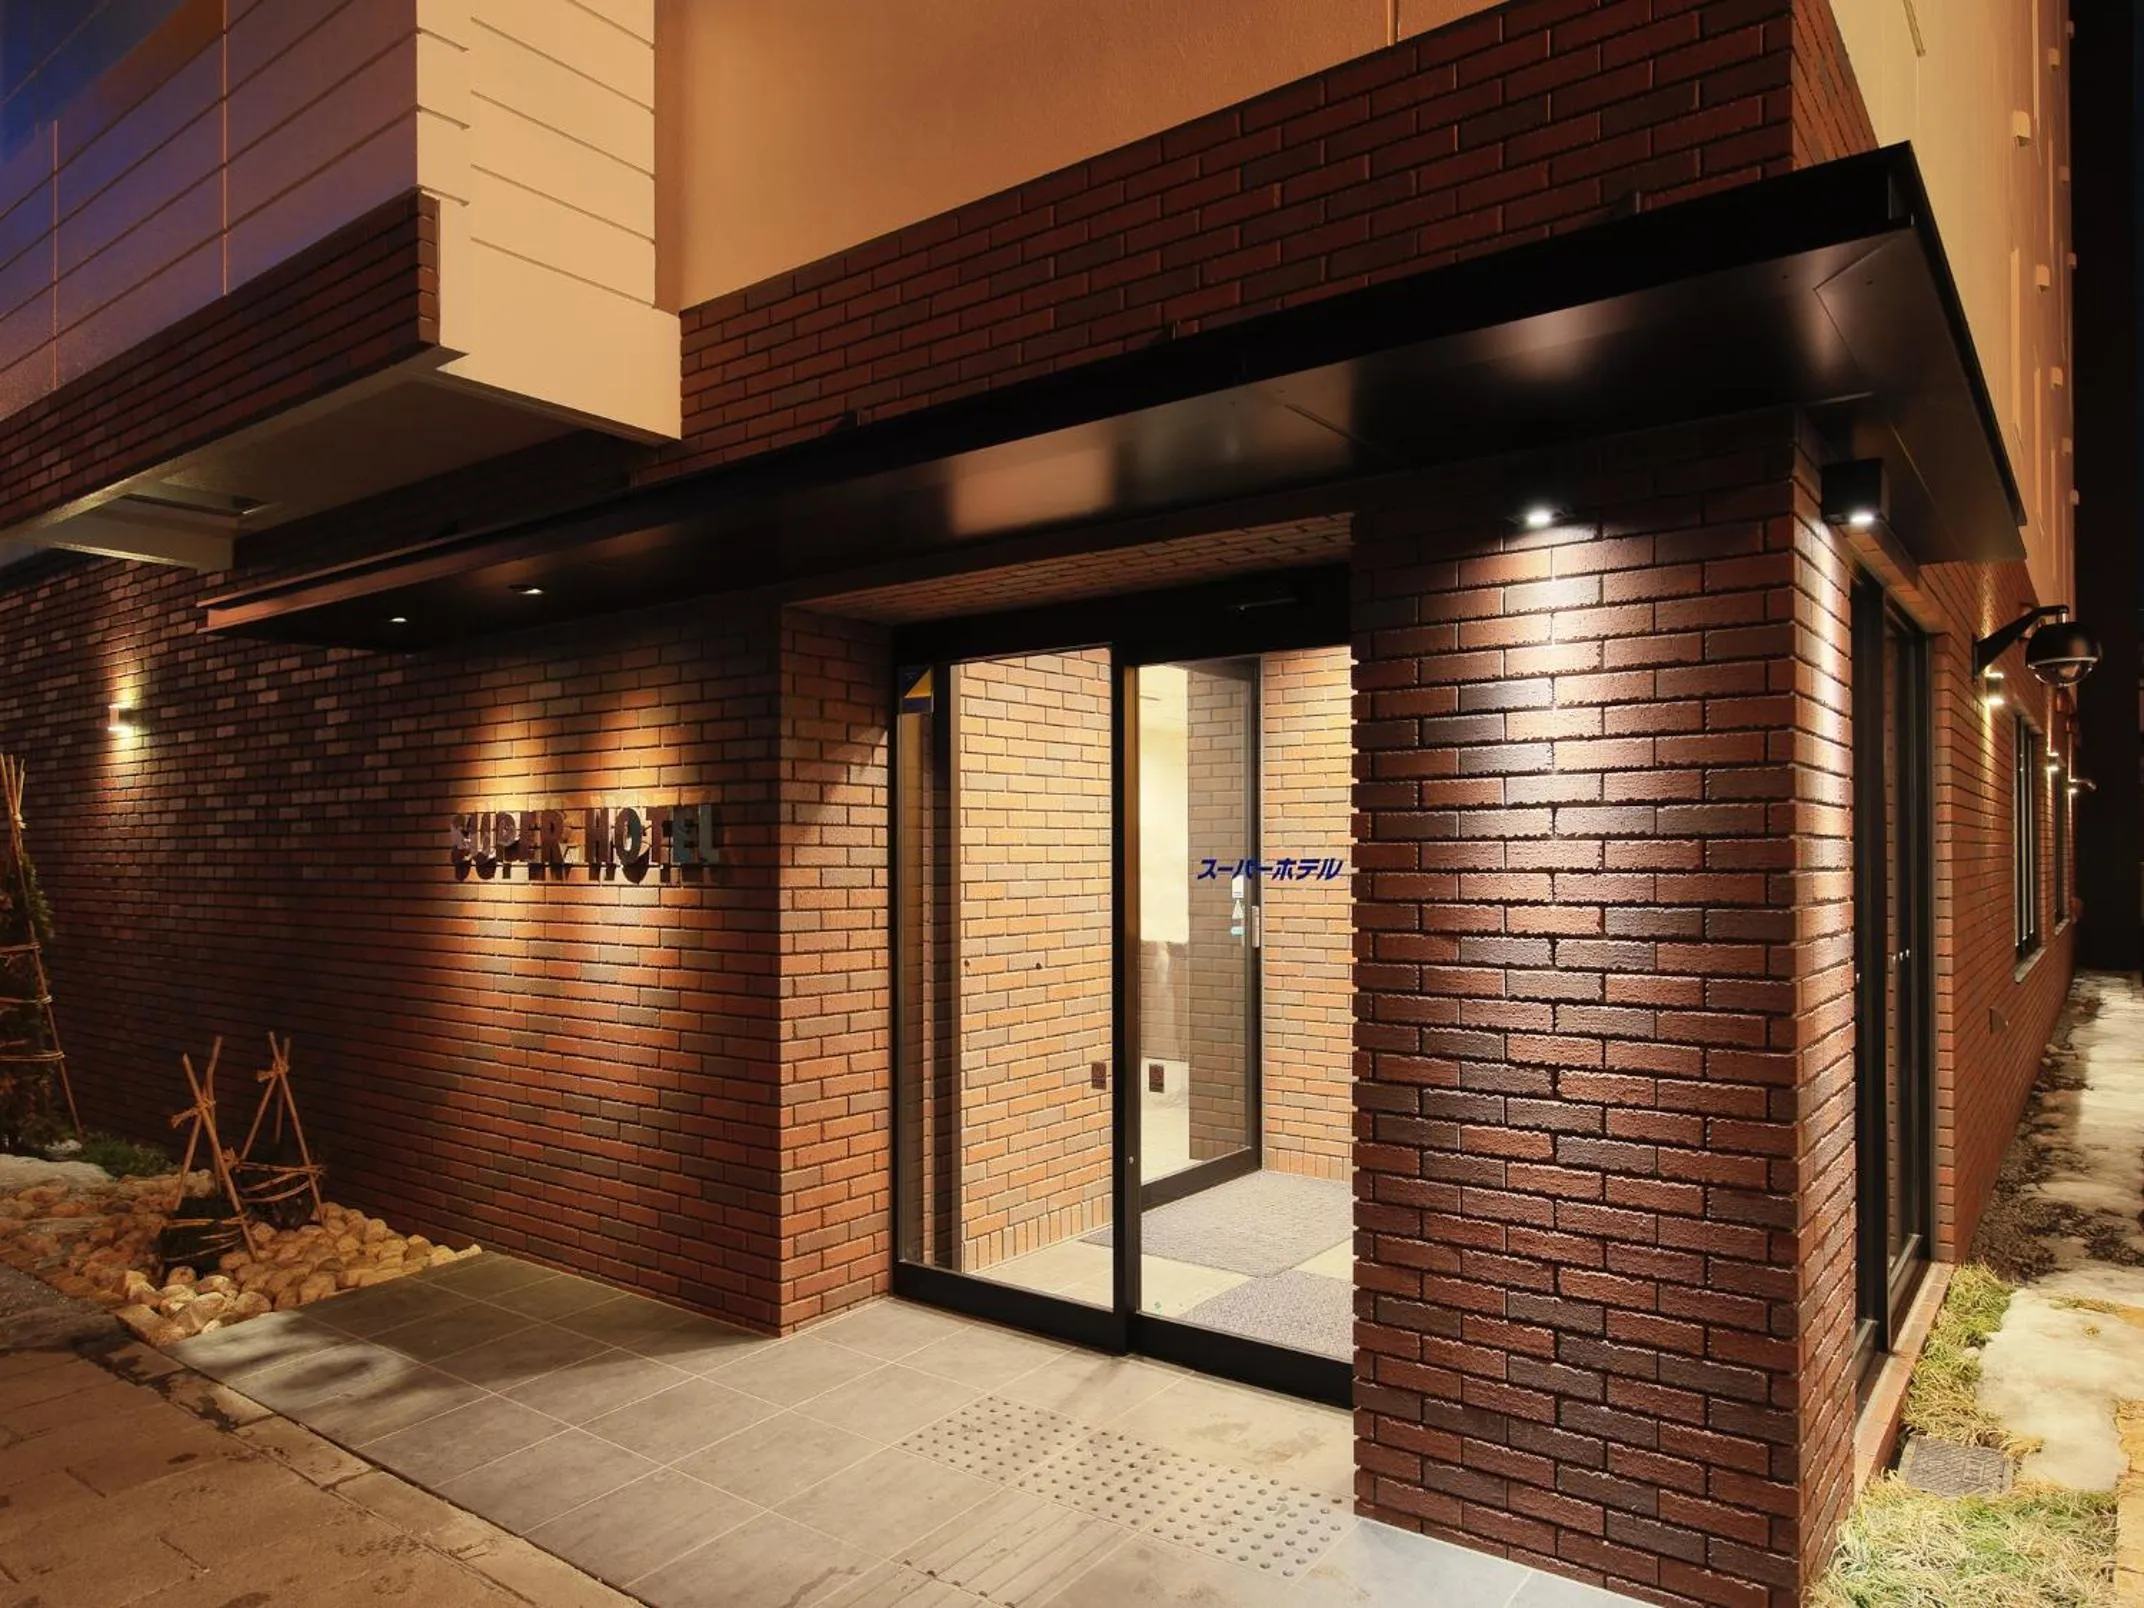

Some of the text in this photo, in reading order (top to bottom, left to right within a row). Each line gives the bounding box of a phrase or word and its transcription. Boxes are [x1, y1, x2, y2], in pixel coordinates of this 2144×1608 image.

[450, 804, 721, 866] SUPER HOTEL
[1197, 858, 1343, 880] スーパーホテル
